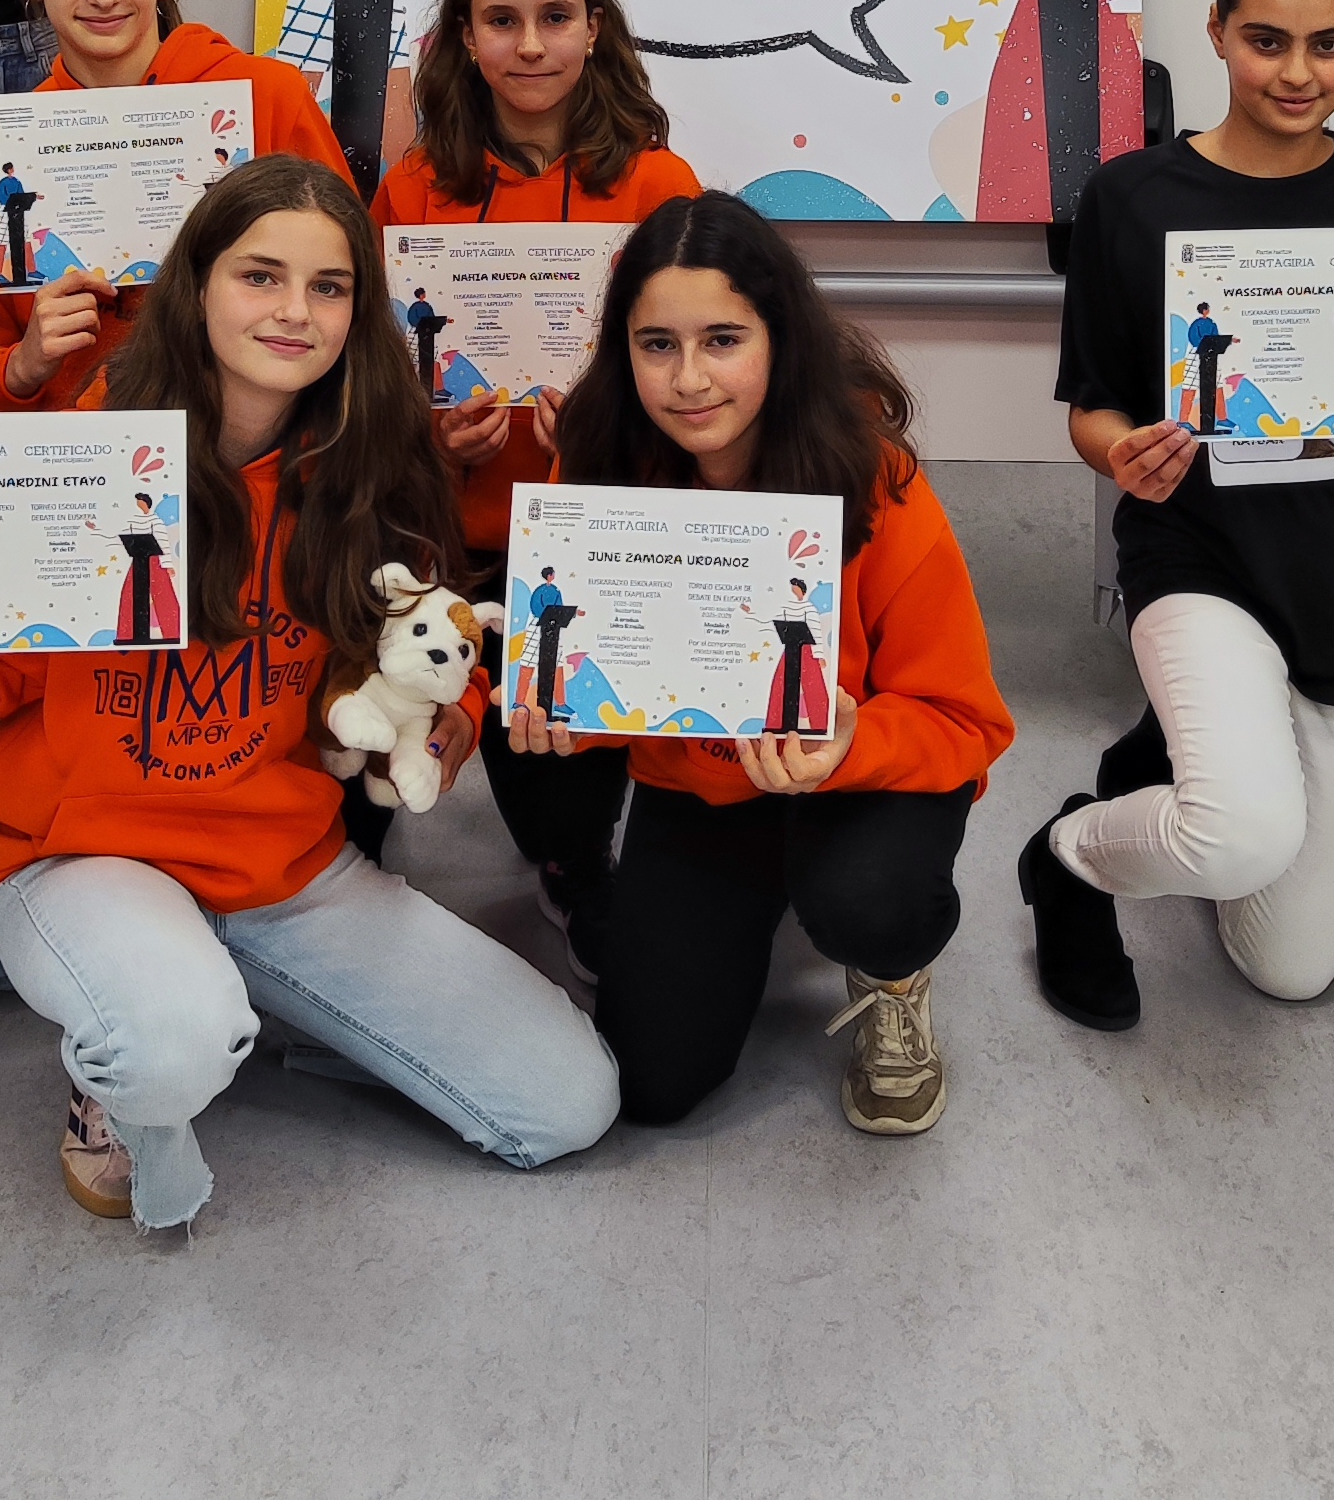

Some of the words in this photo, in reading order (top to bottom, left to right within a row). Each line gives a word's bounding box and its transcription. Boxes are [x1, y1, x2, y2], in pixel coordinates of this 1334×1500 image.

[38, 115, 109, 128] ZIURTAGIRIA
[122, 110, 194, 123] CERTIFICADO
[38, 144, 71, 154] LEYRE
[75, 140, 128, 151] ZURBANO
[131, 137, 183, 148] BUJANDA
[449, 248, 515, 257] ZIURTAGIRIA
[527, 248, 595, 256] CERTIFICADO
[1239, 258, 1316, 268] ZIURTAGIRIA
[452, 273, 488, 282] NAHIA
[491, 272, 526, 281] RUEDA
[1223, 286, 1283, 297] WASSIMA
[24, 444, 112, 455] CERTIFICADO
[63, 476, 106, 487] ETAYO
[588, 519, 668, 533] ZIURTAGIRIA
[684, 523, 769, 537] CERTIFICADO
[587, 551, 621, 562] JUNE
[625, 552, 682, 564] ZAMORA
[687, 555, 749, 568] URDANOZ
[93, 668, 142, 718] 18
